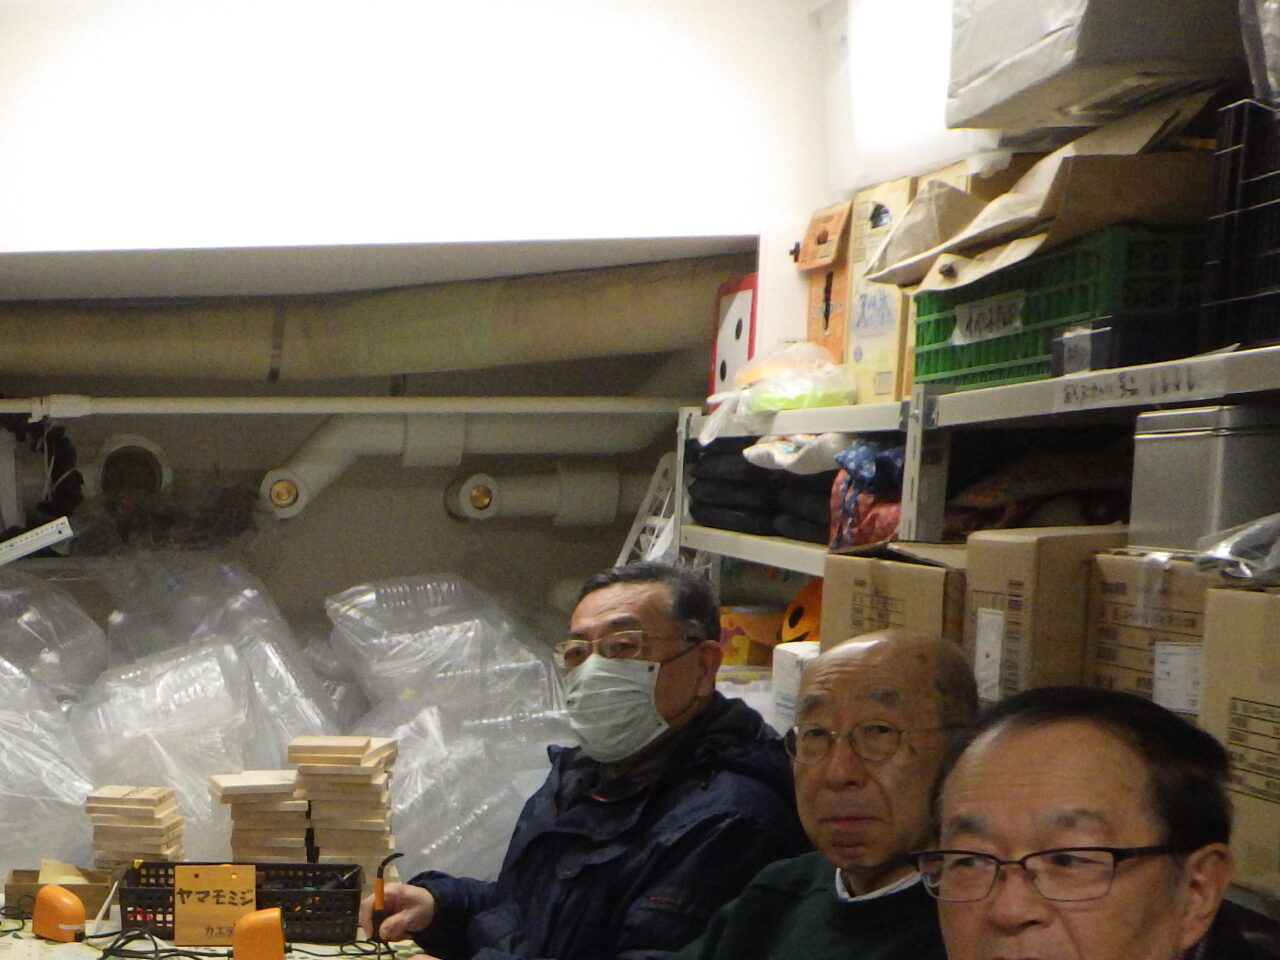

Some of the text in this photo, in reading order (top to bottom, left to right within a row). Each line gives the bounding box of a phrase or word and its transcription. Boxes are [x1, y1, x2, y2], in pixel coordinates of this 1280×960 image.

[176, 888, 254, 906] ヤマモミジ
